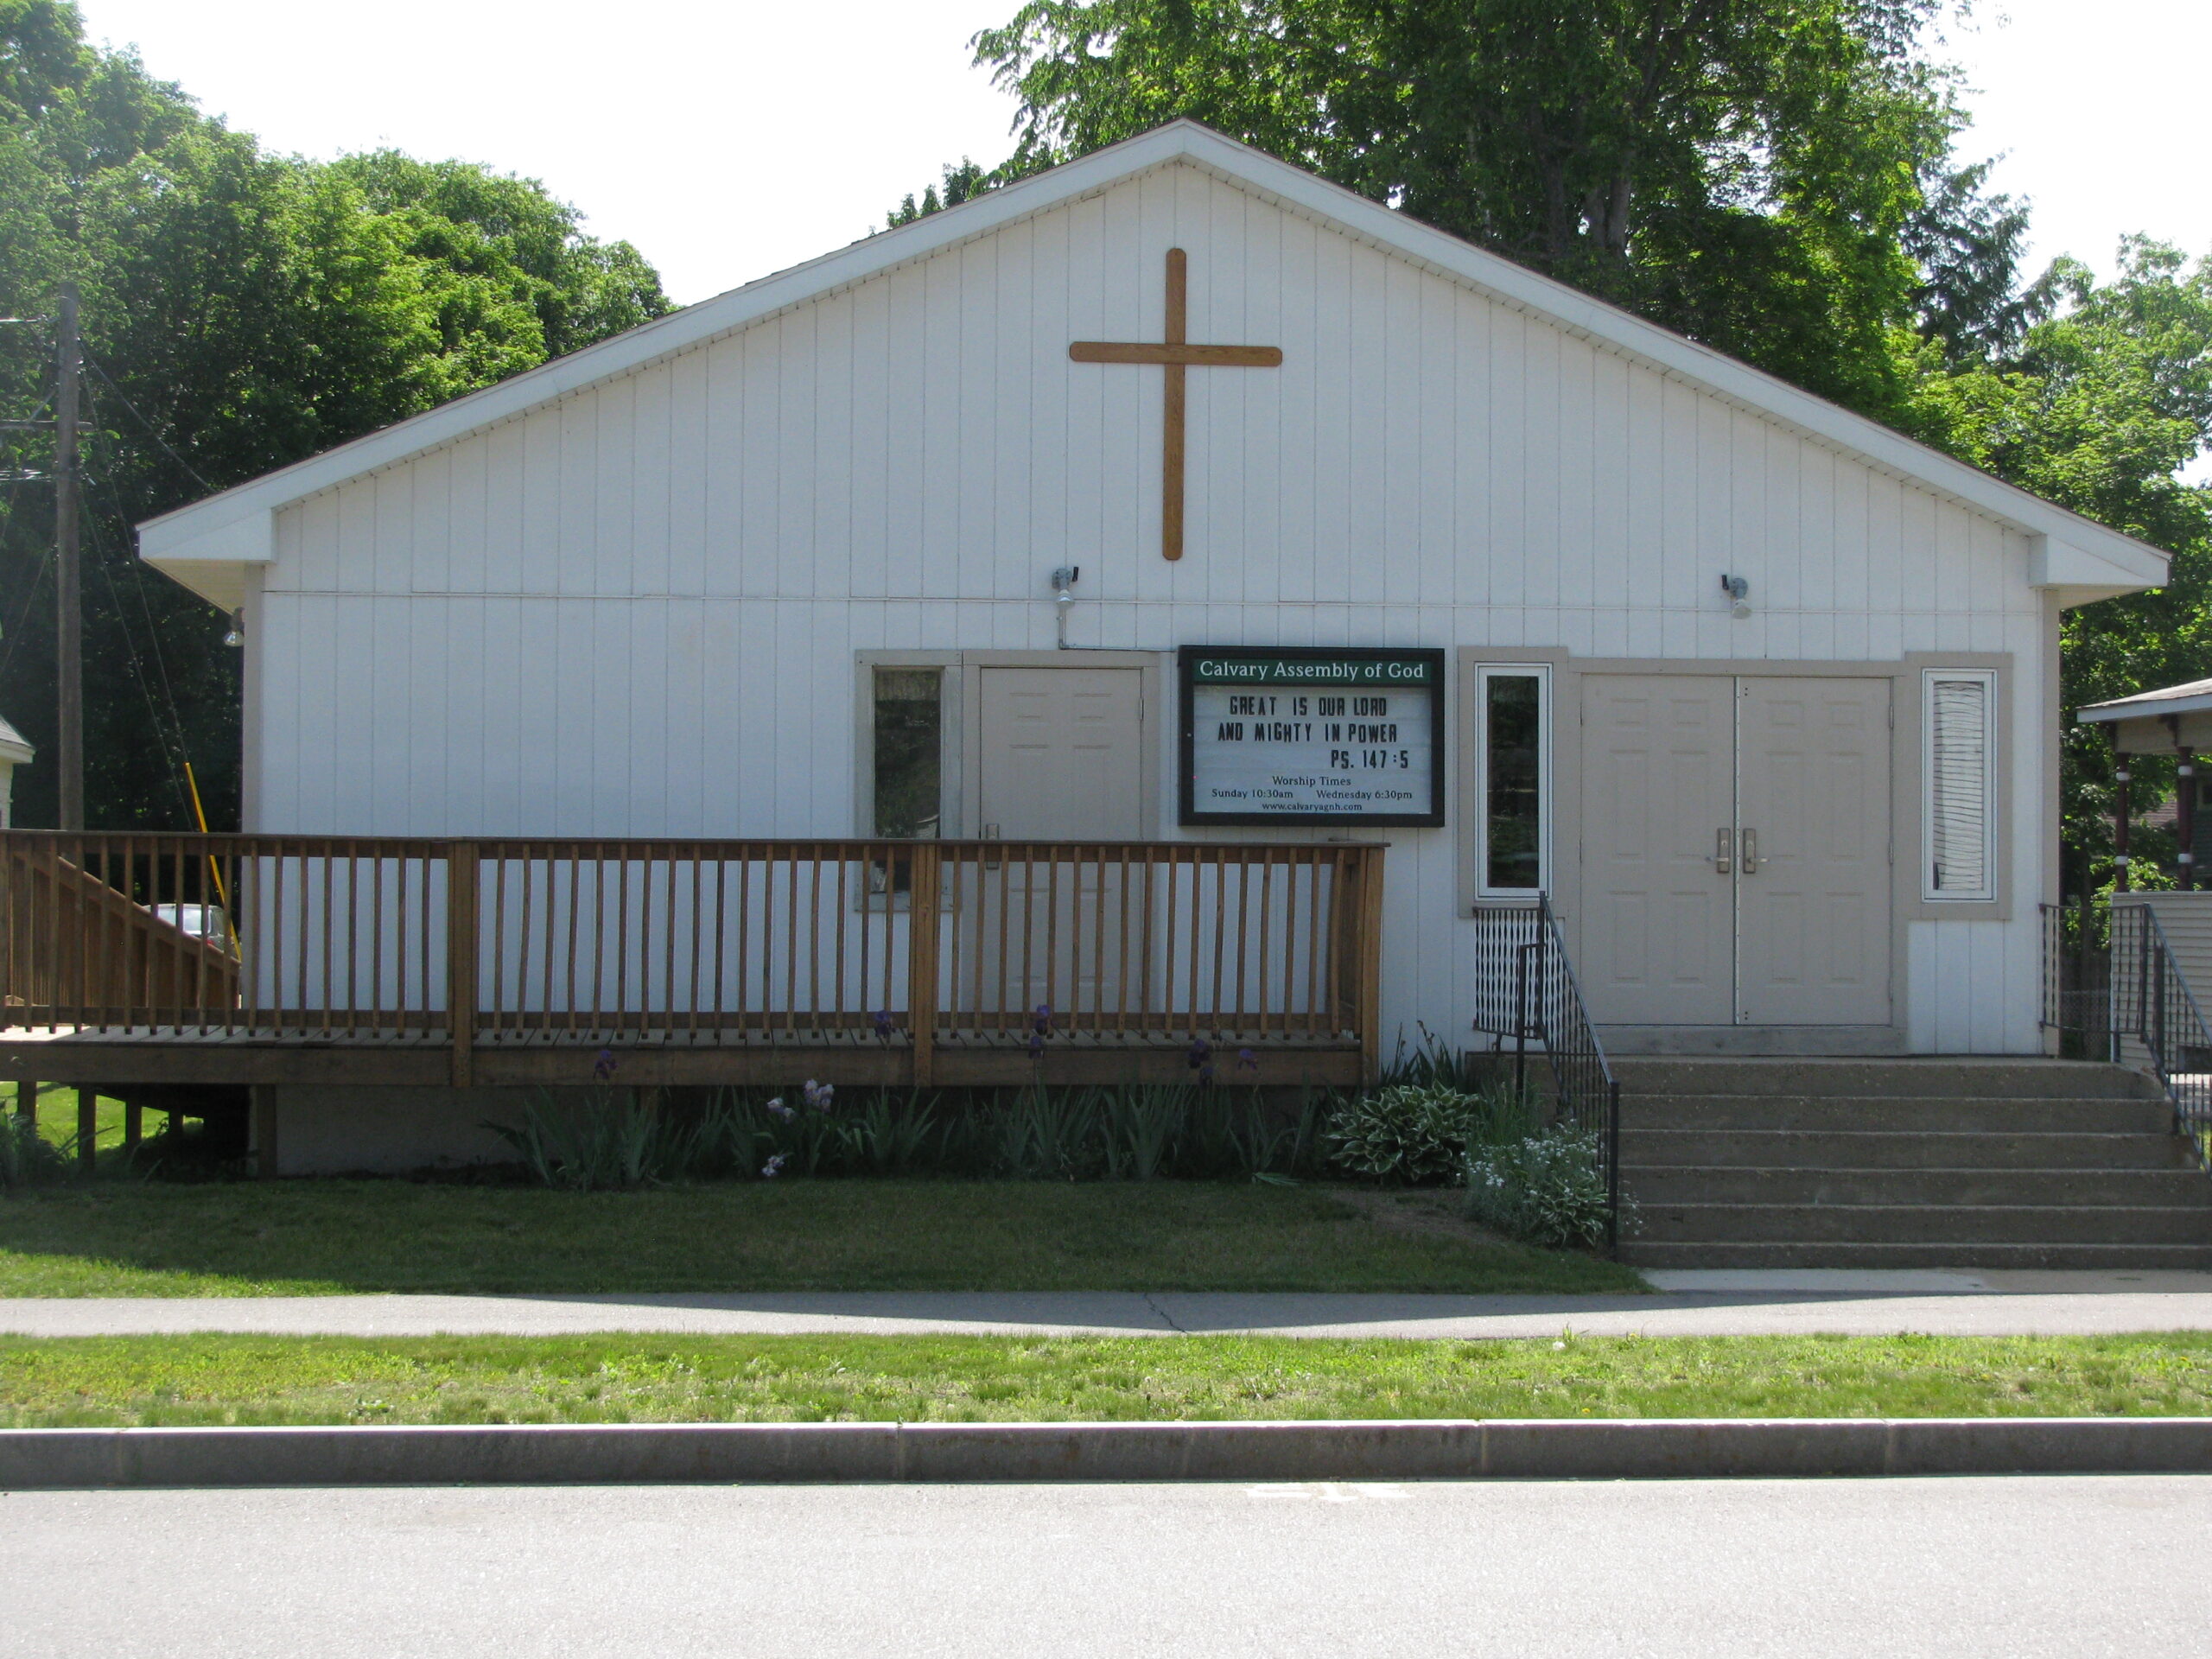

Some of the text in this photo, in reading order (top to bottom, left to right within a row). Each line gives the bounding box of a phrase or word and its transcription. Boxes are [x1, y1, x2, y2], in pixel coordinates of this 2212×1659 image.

[1200, 660, 1424, 681] Calvary Assembly of God
[1230, 696, 1387, 716] GREAT IS OUR LORD
[1218, 722, 1397, 743] AND MIGHTY IN POWER
[1331, 750, 1355, 769] PS.
[1272, 776, 1351, 786] Worship Times
[1211, 788, 1413, 801] Sunday 10:30am Wednesday 6:30pm
[1262, 802, 1363, 812] www.calvaryagnh.com
